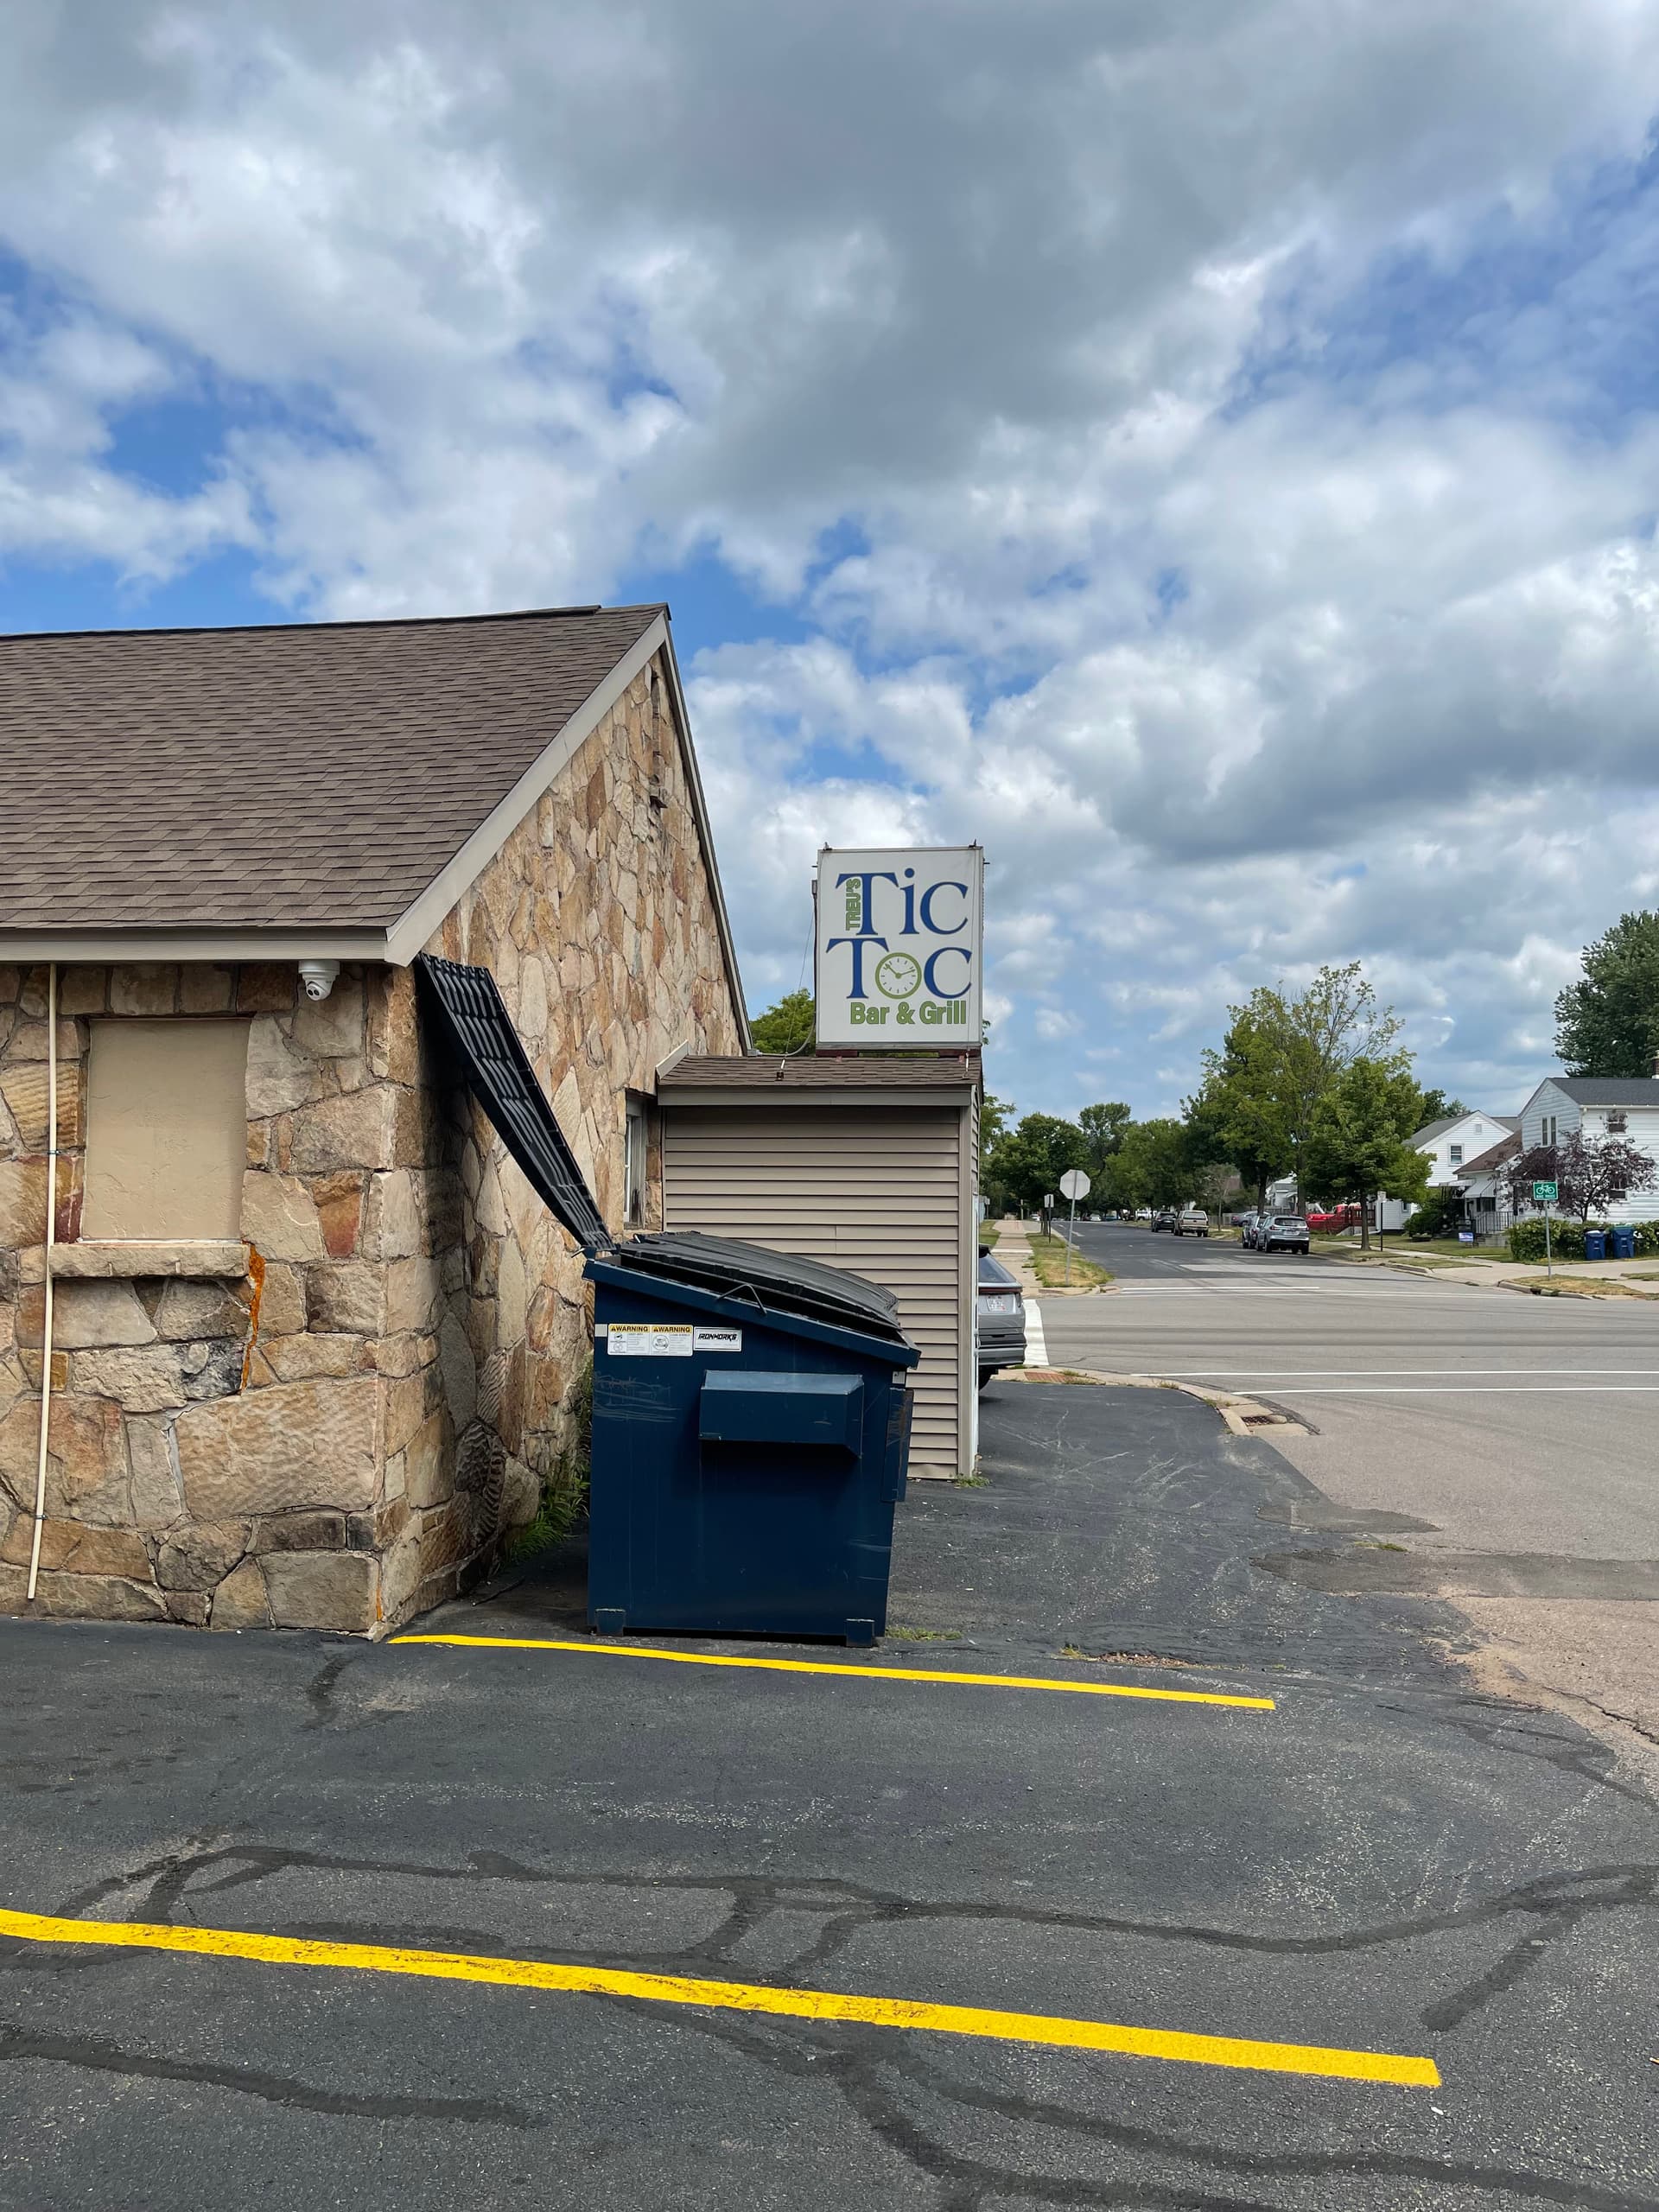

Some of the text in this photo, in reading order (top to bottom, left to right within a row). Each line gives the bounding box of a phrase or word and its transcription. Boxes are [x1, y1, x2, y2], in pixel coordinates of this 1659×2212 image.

[850, 1001, 966, 1025] Bar & Grill
